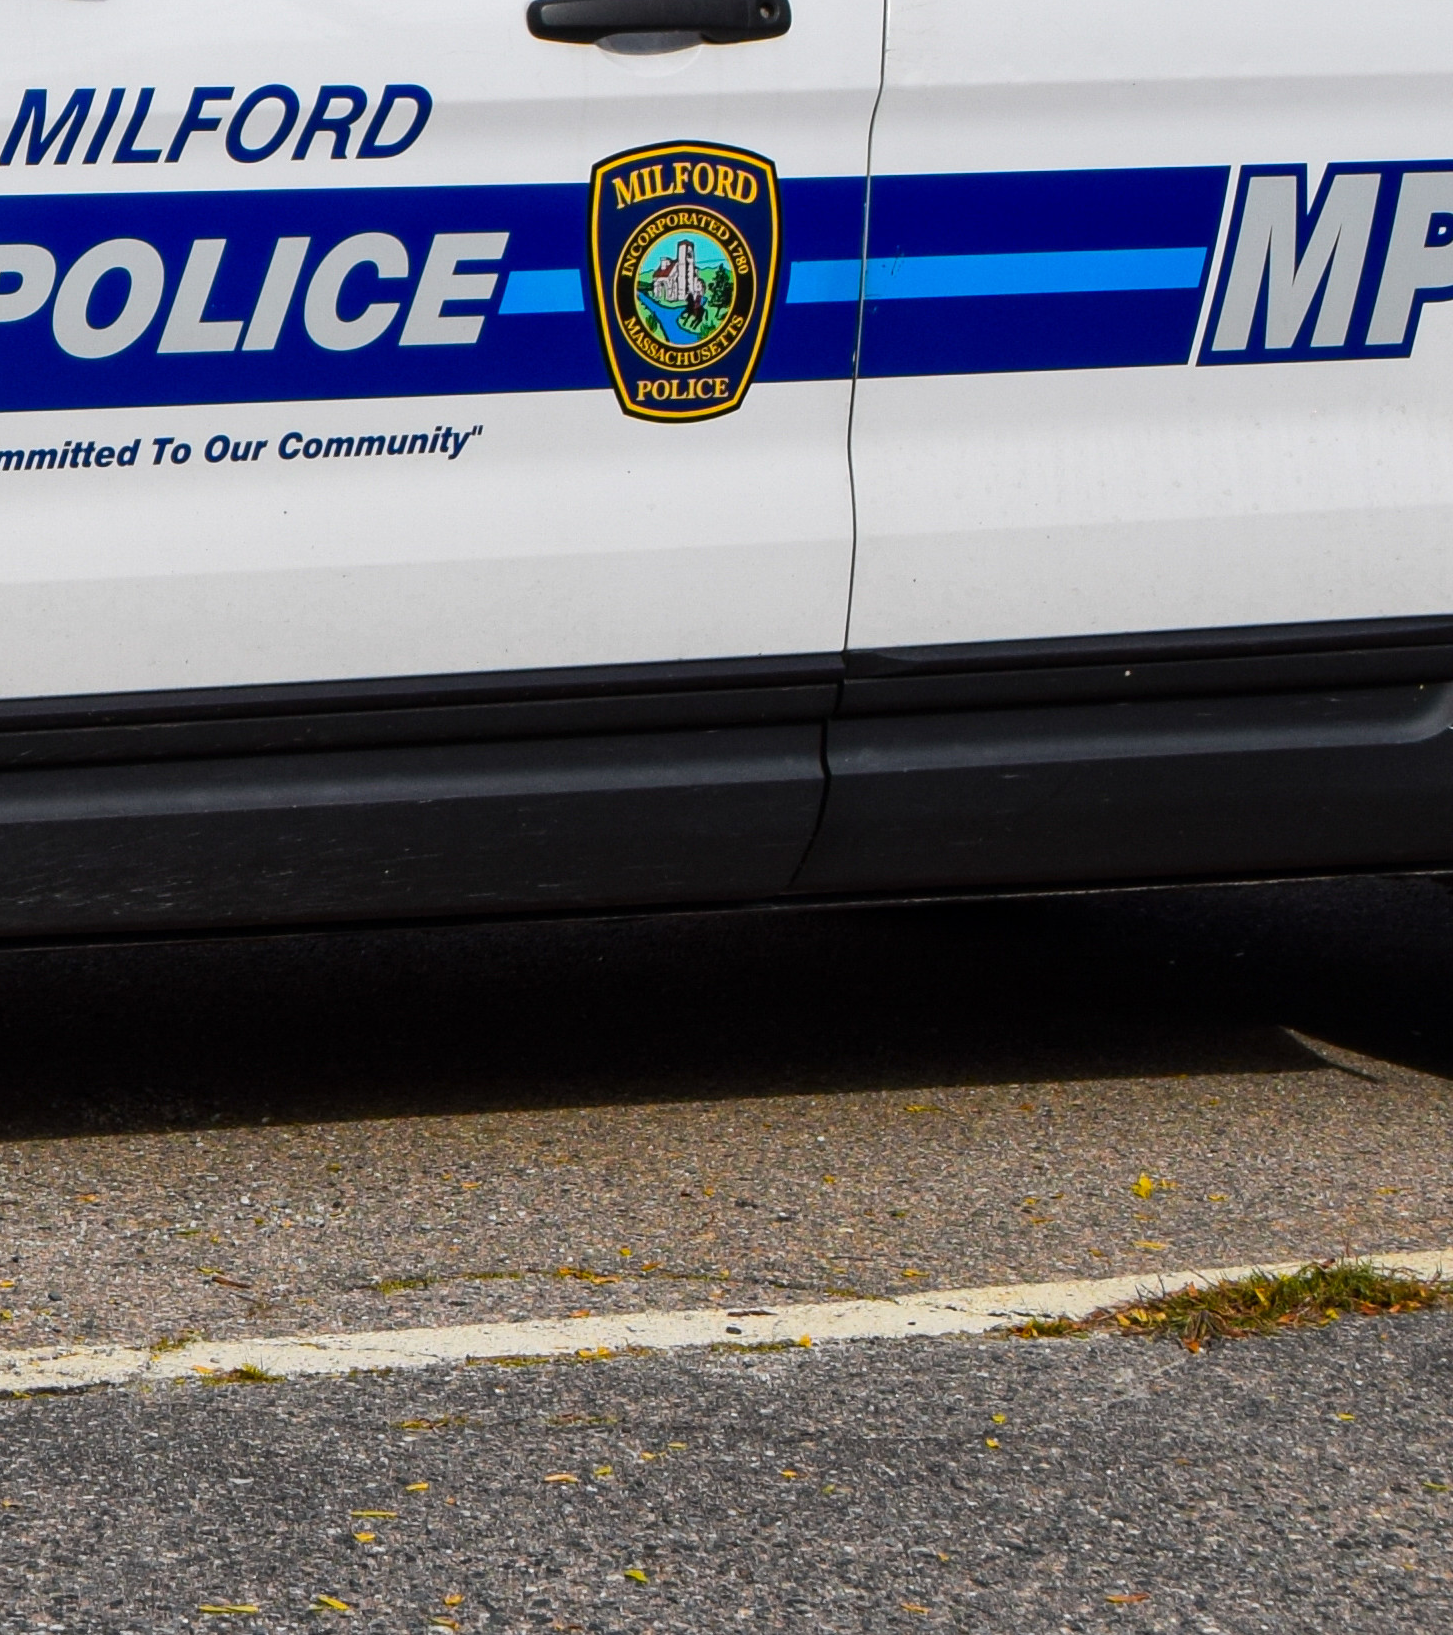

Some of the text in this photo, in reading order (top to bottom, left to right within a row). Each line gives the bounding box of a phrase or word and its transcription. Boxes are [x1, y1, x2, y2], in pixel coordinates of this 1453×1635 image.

[611, 161, 758, 210] MILFORD
[621, 212, 749, 277] INCORPORATED 1780
[624, 315, 744, 366] MASSACHUSETTS
[635, 377, 729, 402] POLICE
[153, 437, 192, 464] To
[204, 434, 268, 463] Our
[278, 424, 484, 460] Community"
